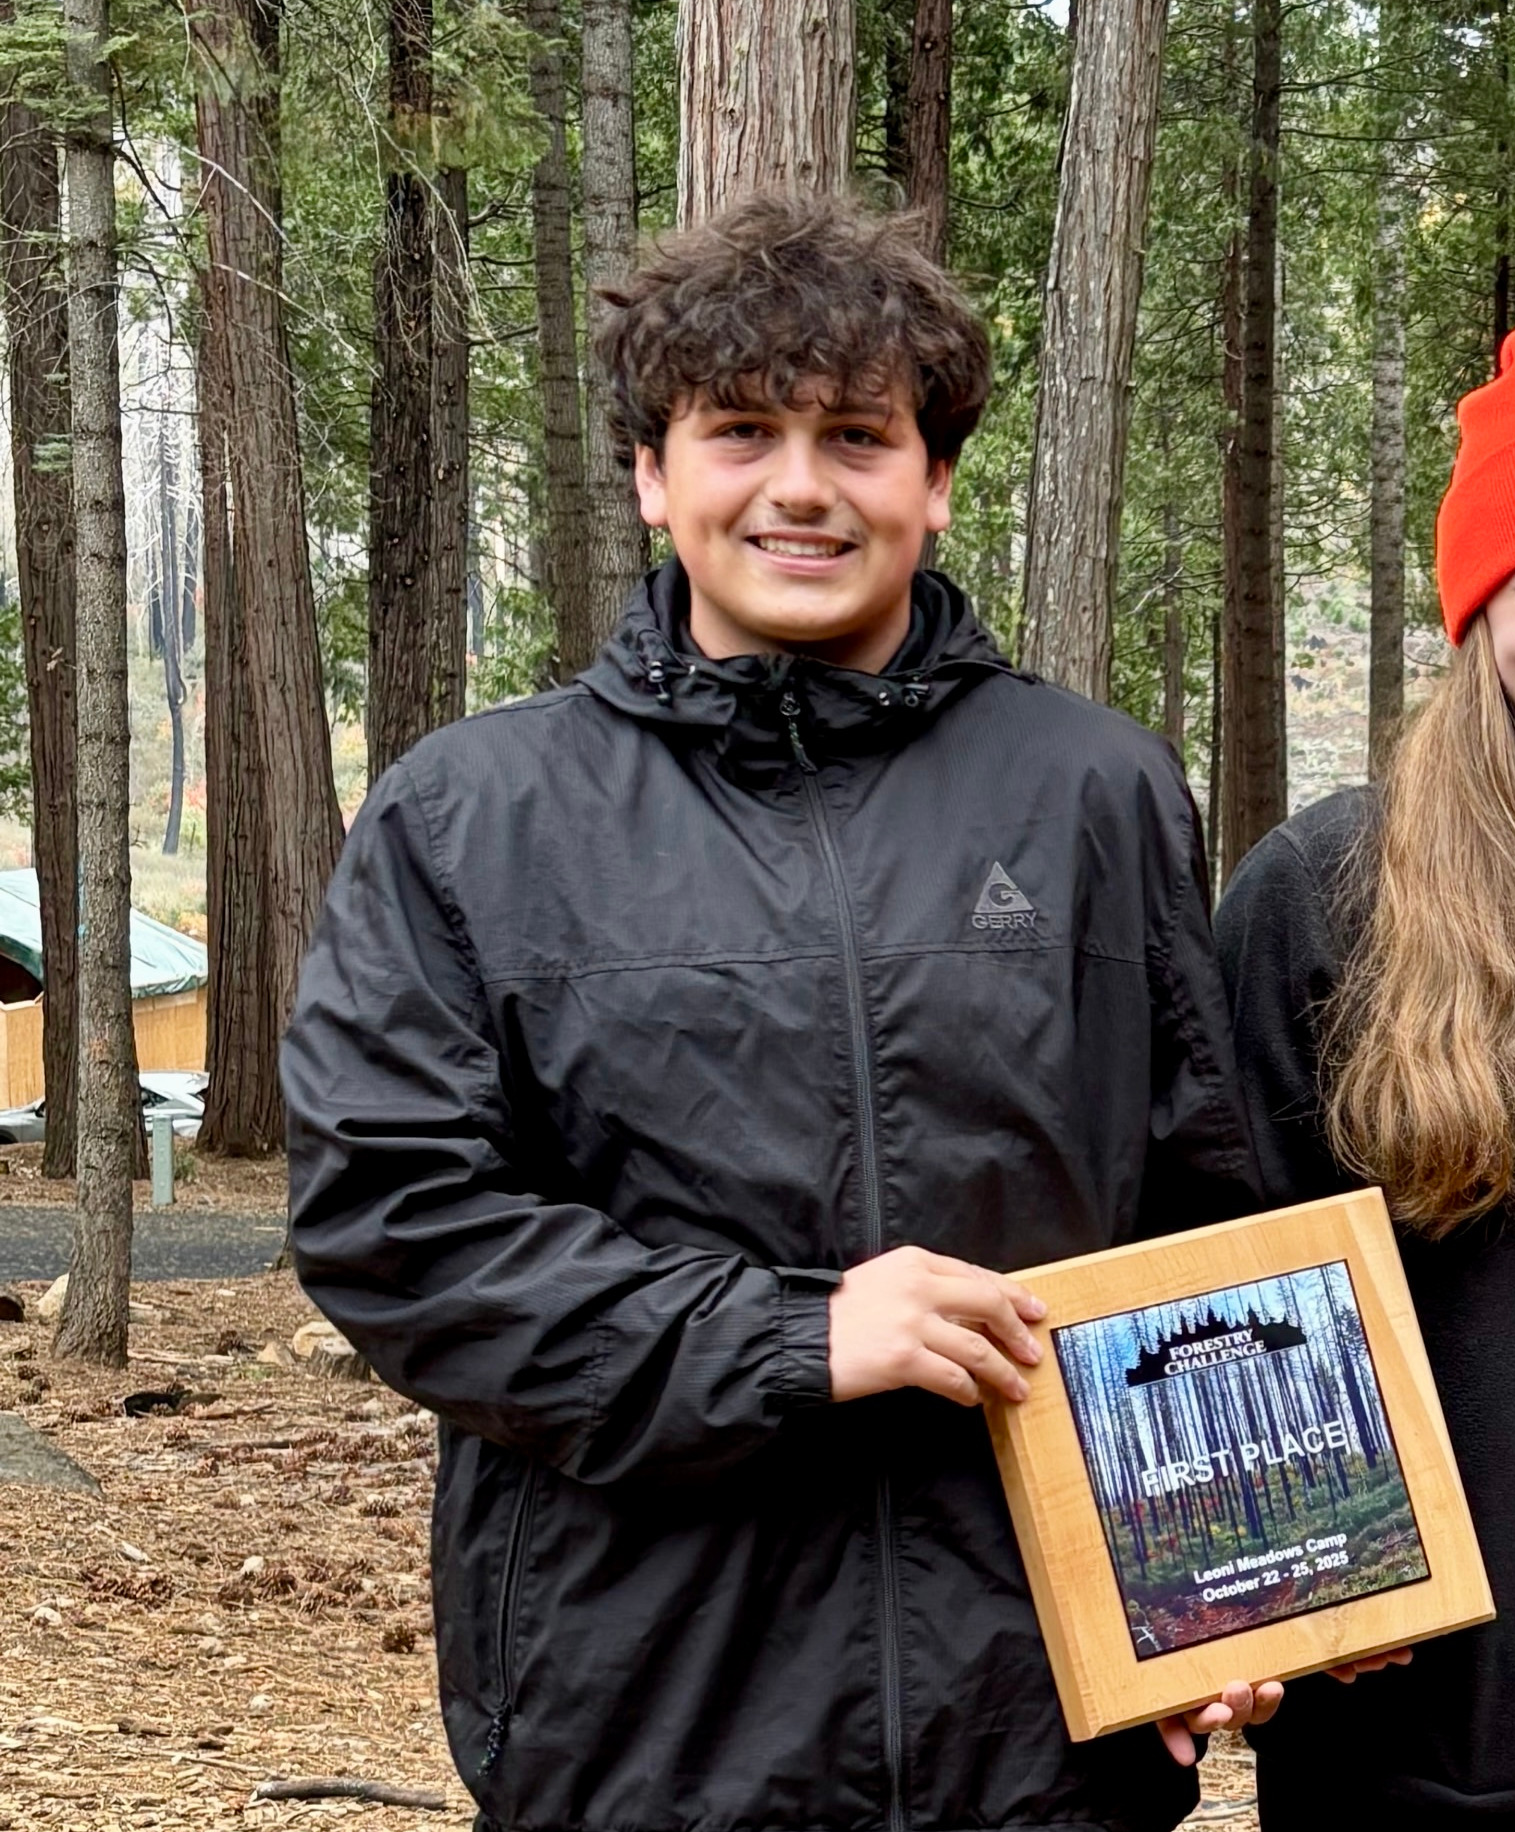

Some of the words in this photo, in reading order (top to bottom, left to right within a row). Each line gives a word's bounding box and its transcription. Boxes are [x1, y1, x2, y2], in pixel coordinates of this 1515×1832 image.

[971, 911, 1038, 930] GERRY
[1163, 1340, 1267, 1376] CHALLENGE
[1169, 1328, 1254, 1361] FORESTRY
[1141, 1449, 1231, 1498] FIRST
[1240, 1420, 1347, 1471] PLACE
[1193, 1560, 1236, 1584] Leoni
[1236, 1545, 1304, 1573] Meadows
[1305, 1533, 1347, 1552] Camp
[1202, 1576, 1260, 1603] October
[1262, 1569, 1281, 1586] 22
[1291, 1561, 1314, 1578] 25,
[1315, 1551, 1349, 1571] 2025
